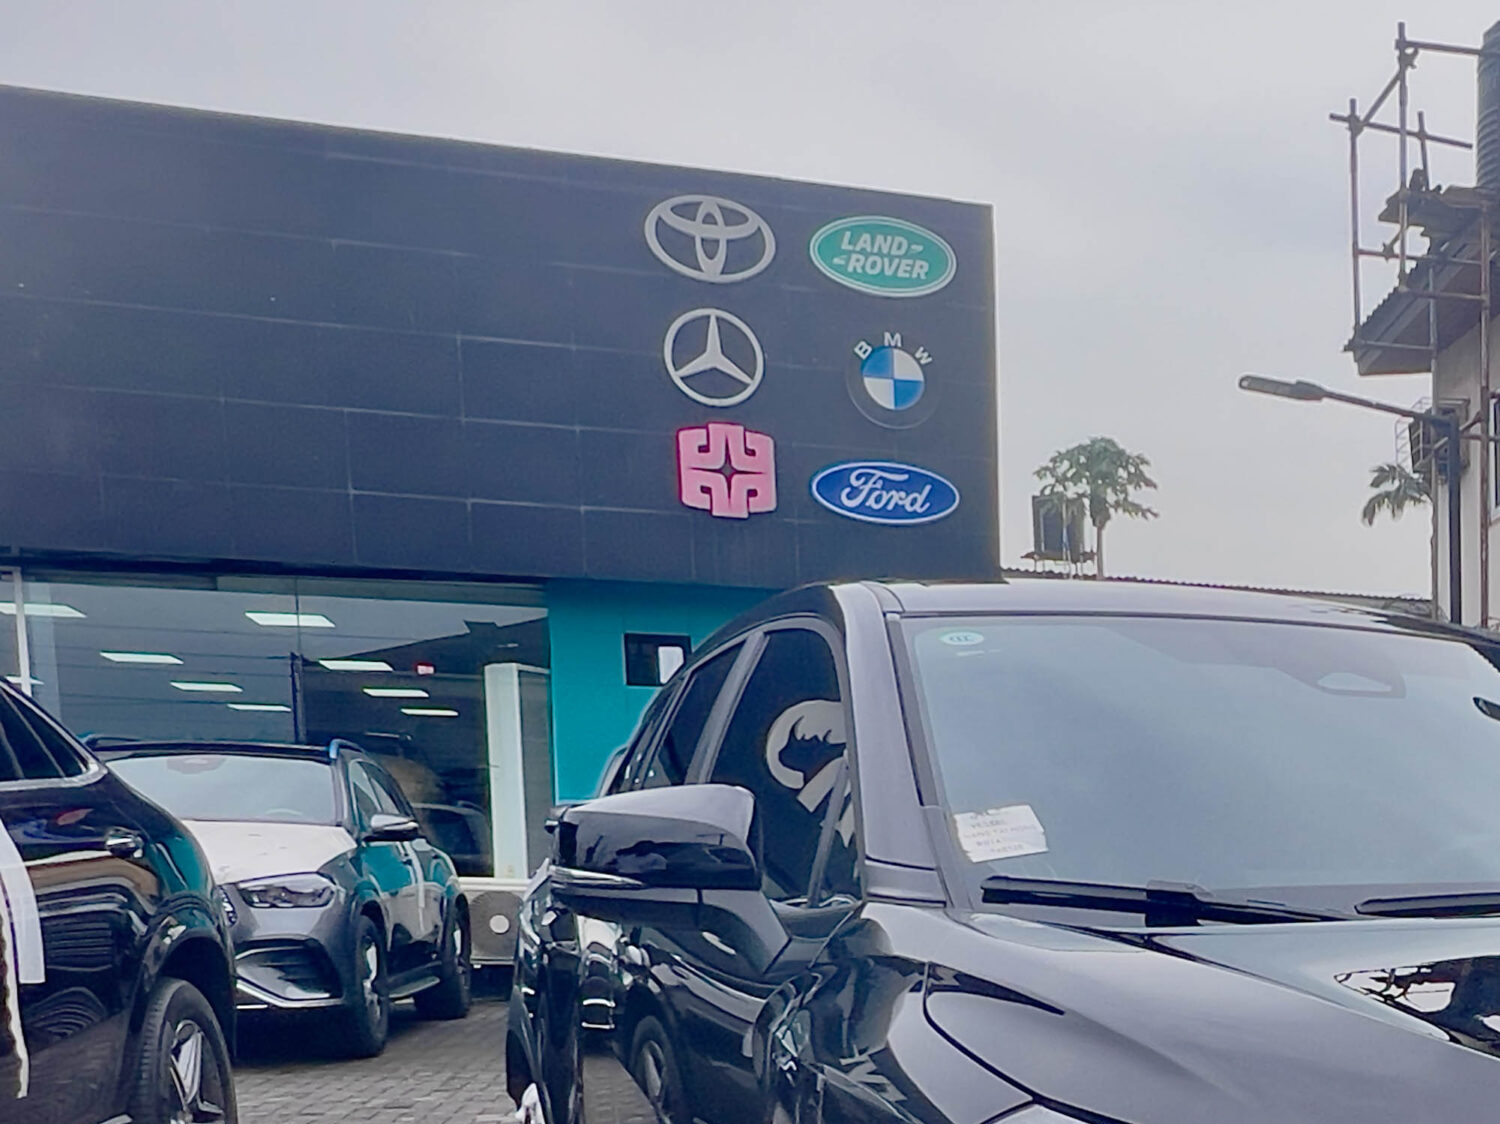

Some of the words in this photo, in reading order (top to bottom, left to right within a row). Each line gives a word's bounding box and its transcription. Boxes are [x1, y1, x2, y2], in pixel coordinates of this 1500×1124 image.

[847, 253, 929, 280] ROVER
[853, 331, 933, 365] BMW
[841, 468, 932, 513] Ford
